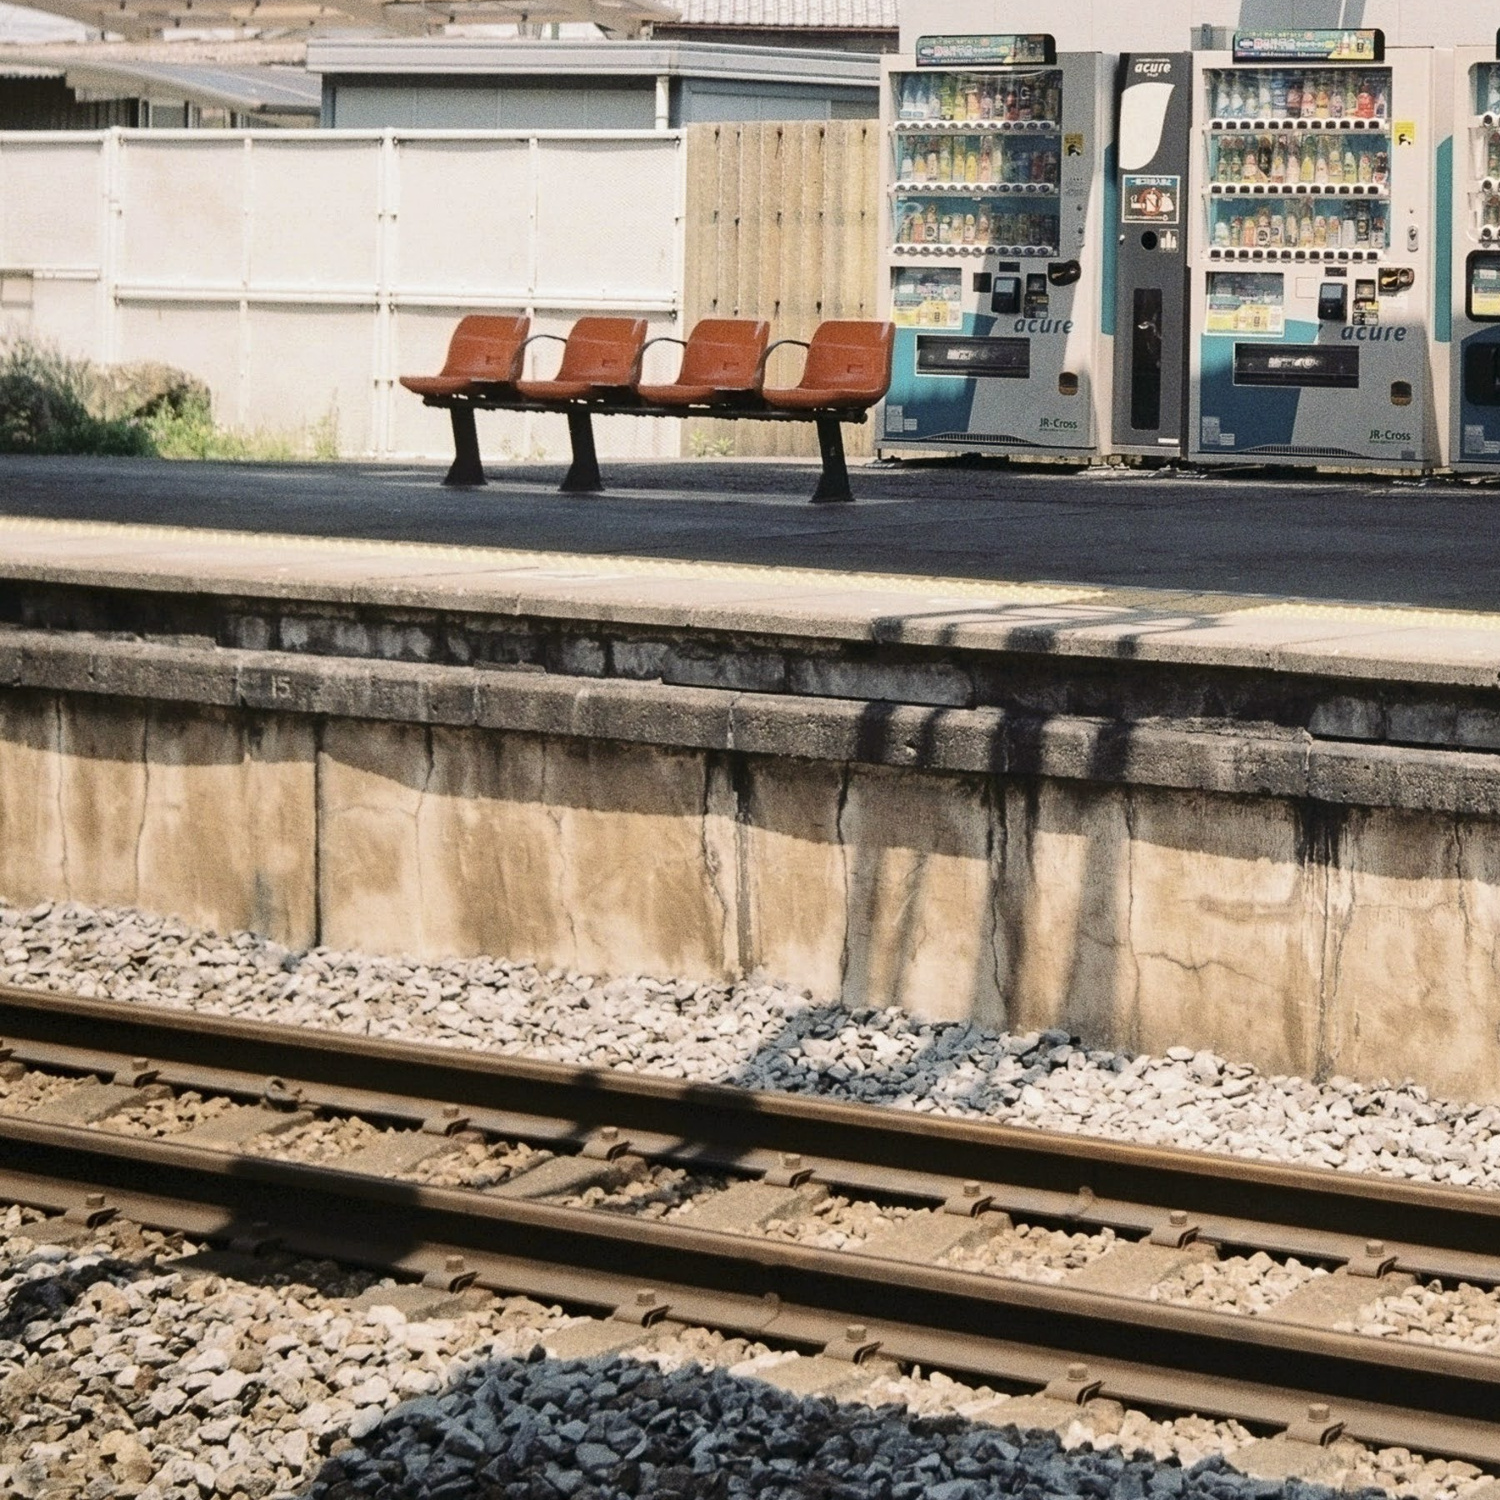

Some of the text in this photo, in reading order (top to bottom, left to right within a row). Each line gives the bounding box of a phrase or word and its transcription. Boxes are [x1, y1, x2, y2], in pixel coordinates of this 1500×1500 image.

[1134, 63, 1171, 73] acure
[1013, 318, 1074, 334] acure
[1341, 326, 1407, 341] acure
[1039, 418, 1078, 429] JR-Cross
[1369, 429, 1411, 440] JR-Cross
[271, 674, 292, 699] 15
